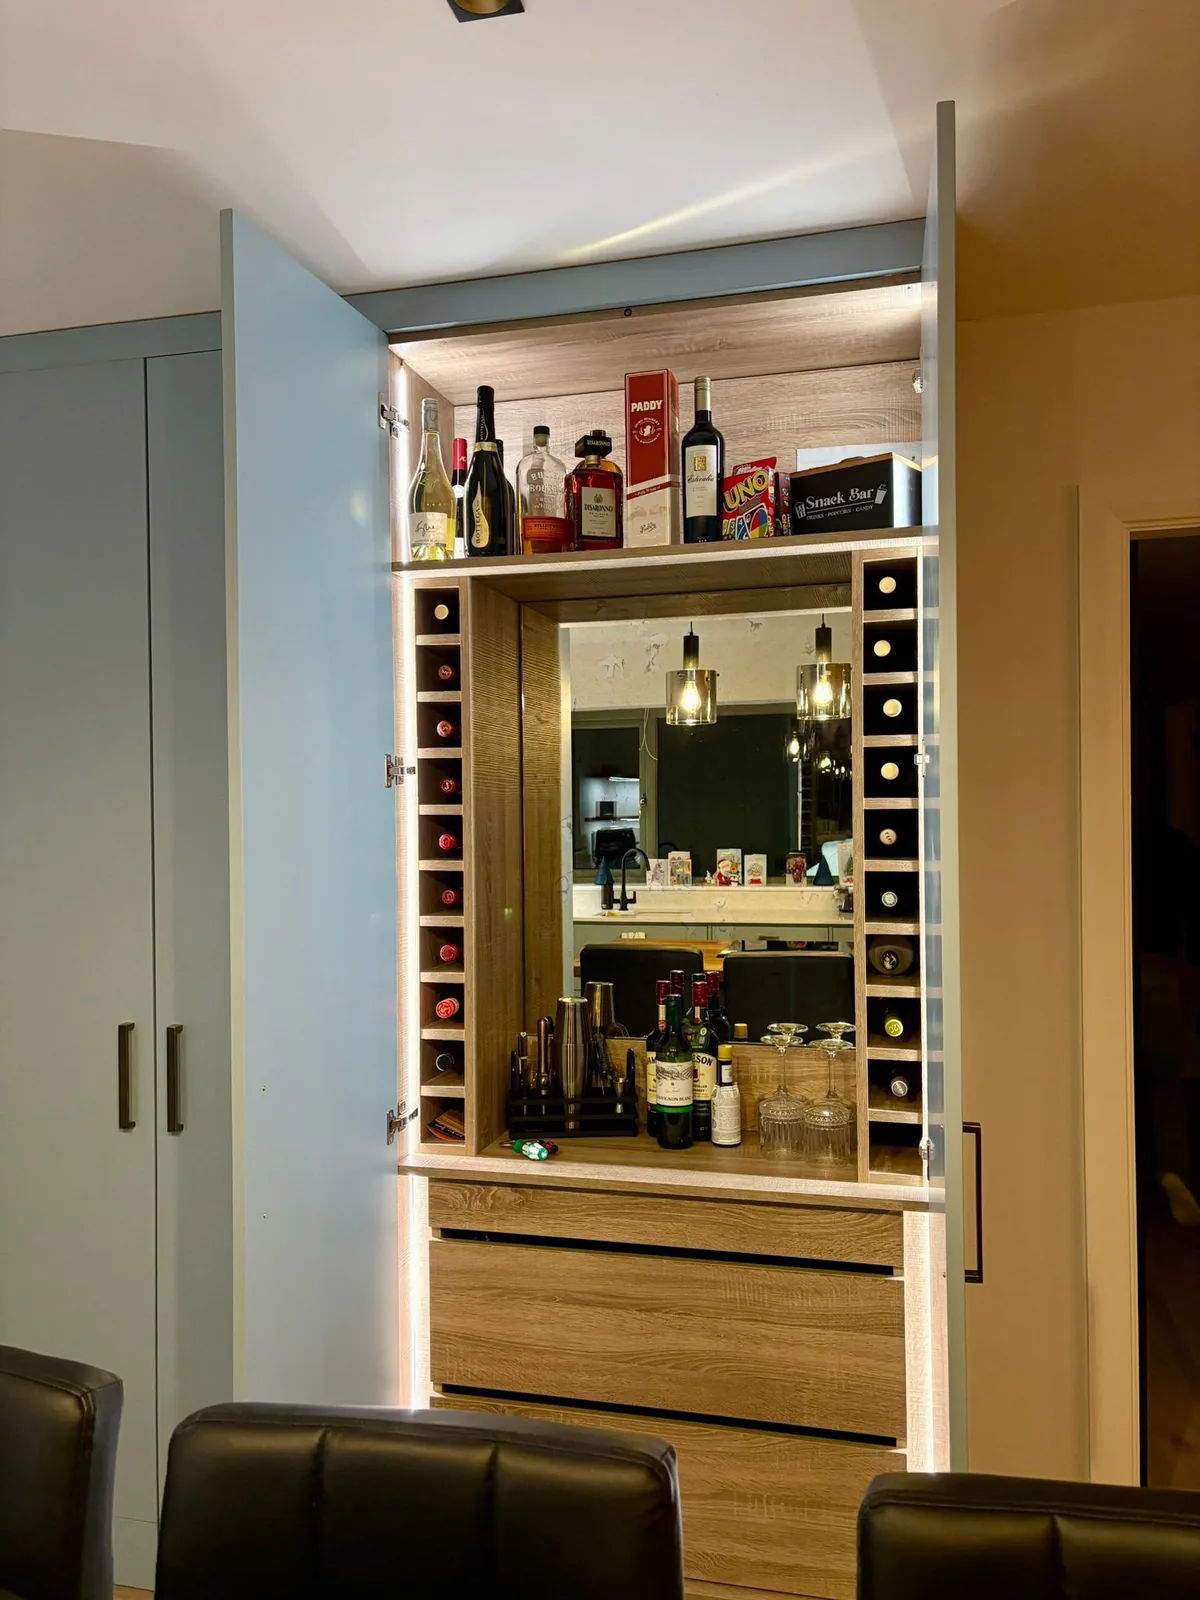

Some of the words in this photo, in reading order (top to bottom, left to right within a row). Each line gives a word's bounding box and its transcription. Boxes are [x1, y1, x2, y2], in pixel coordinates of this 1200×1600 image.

[631, 400, 663, 412] PADDY
[723, 470, 769, 510] UNO
[806, 491, 845, 509] Snack
[848, 487, 875, 502] Bar
[584, 503, 613, 512] DISARONNO
[827, 508, 852, 518] POPCORN
[855, 504, 874, 513] CANDY
